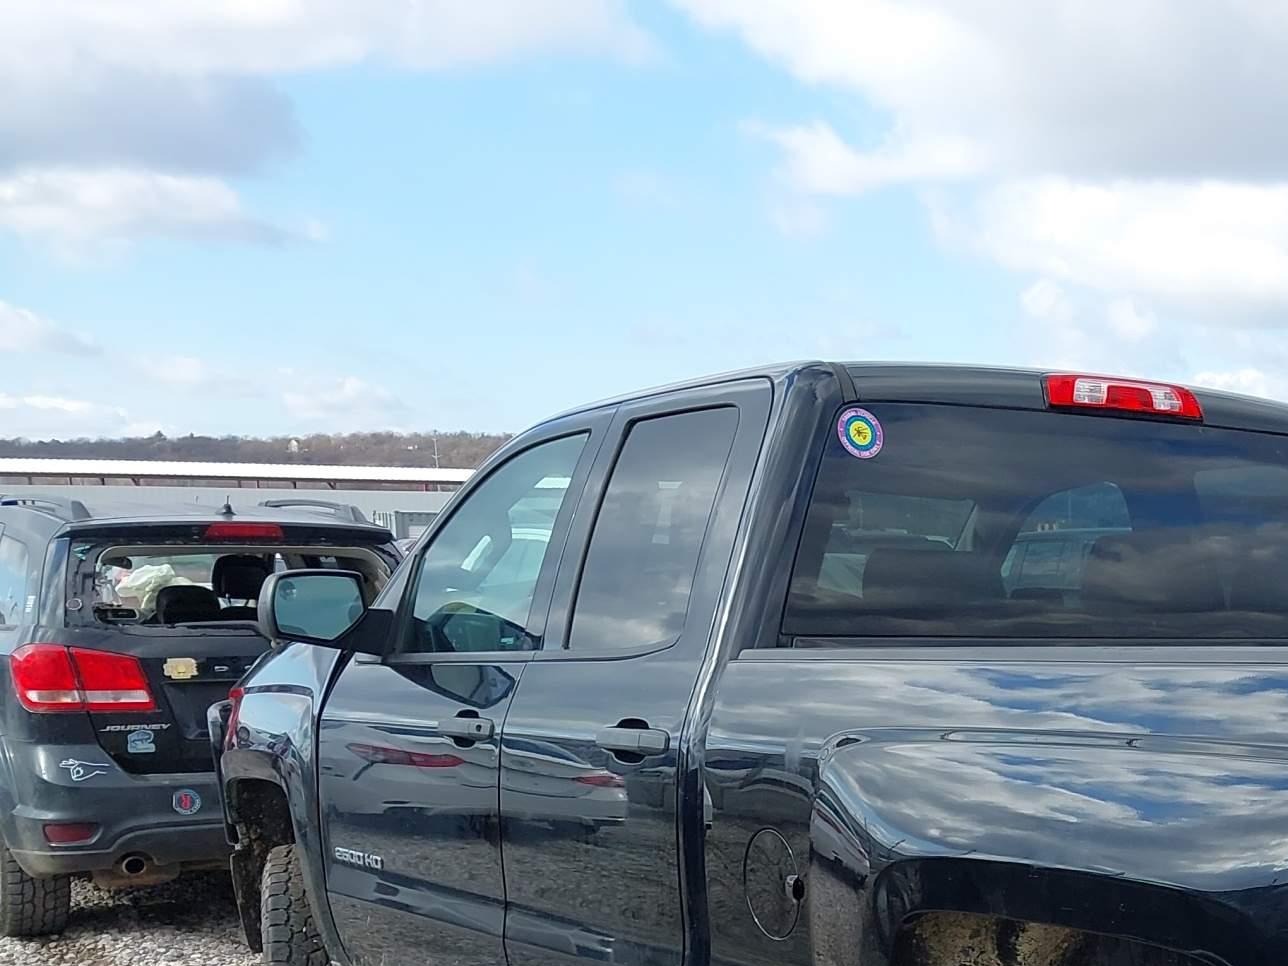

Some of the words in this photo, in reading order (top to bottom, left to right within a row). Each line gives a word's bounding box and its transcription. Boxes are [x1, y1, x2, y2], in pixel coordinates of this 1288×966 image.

[99, 723, 171, 732] JOURNEY
[335, 846, 363, 865] 2500
[364, 853, 382, 870] HD
